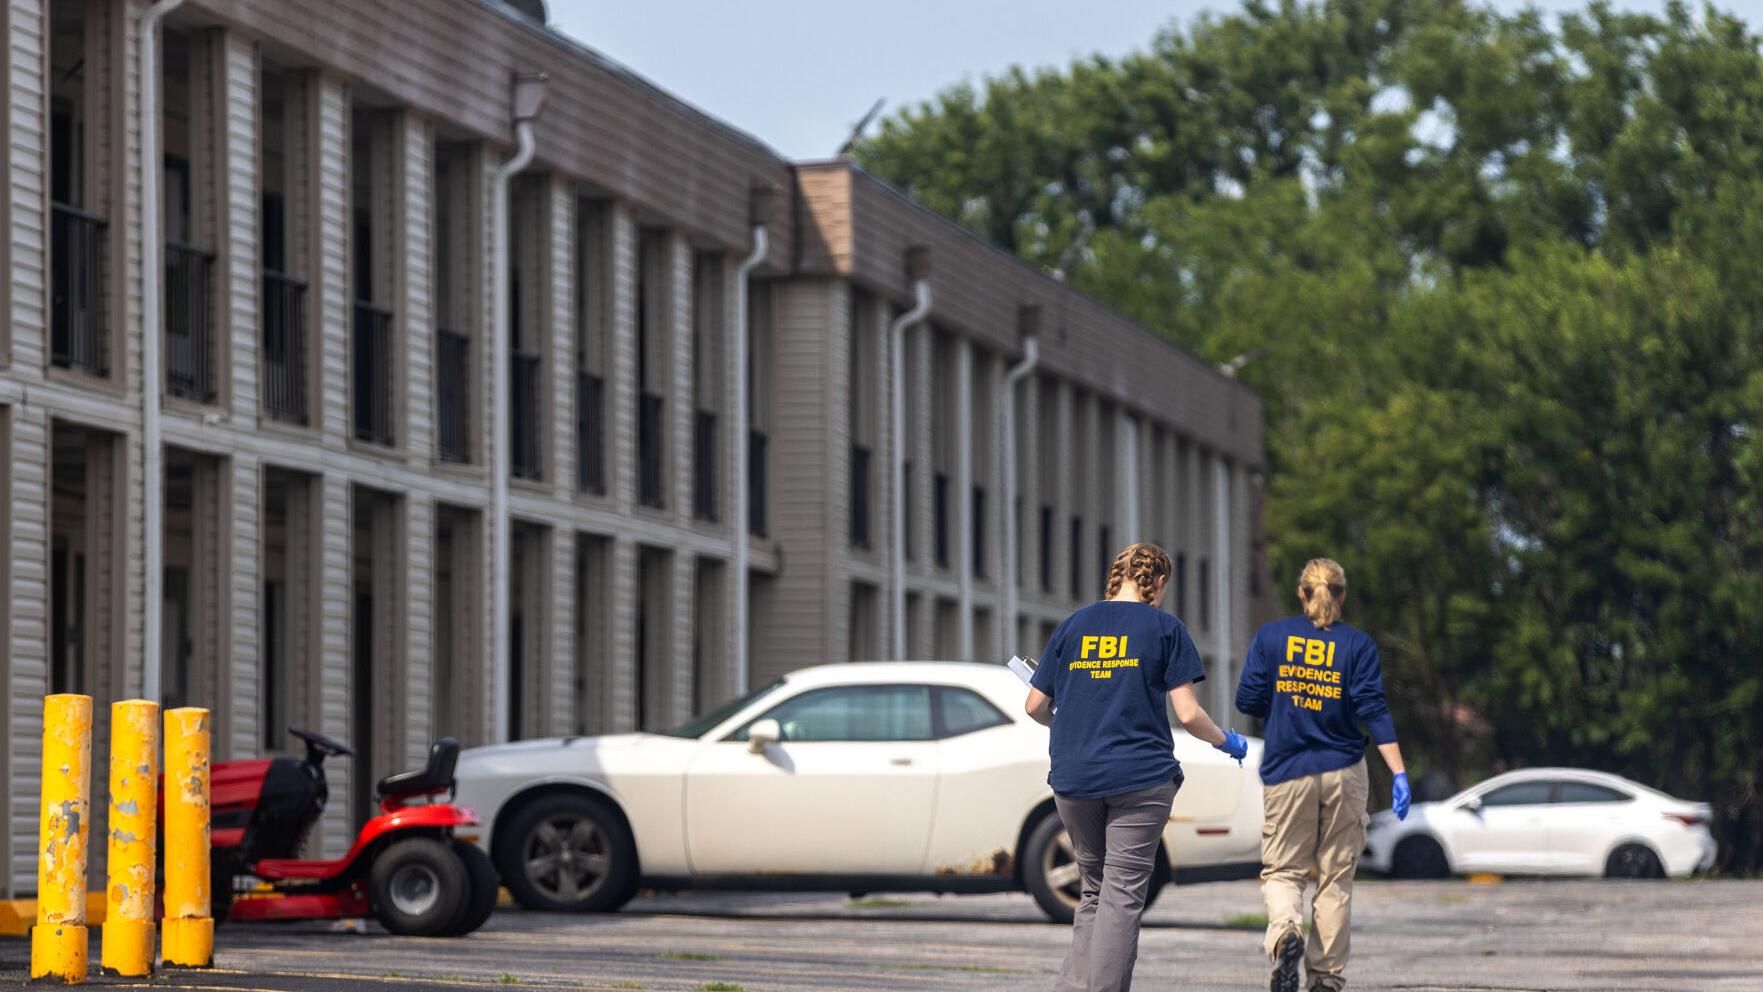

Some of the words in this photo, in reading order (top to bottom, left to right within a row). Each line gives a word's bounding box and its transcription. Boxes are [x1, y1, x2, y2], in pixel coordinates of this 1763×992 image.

[1081, 636, 1128, 659] FBI
[1286, 636, 1335, 667] FBI
[1102, 659, 1139, 668] RESPONSE
[1090, 670, 1112, 679] TEAM
[1276, 680, 1342, 699] RESPONSE
